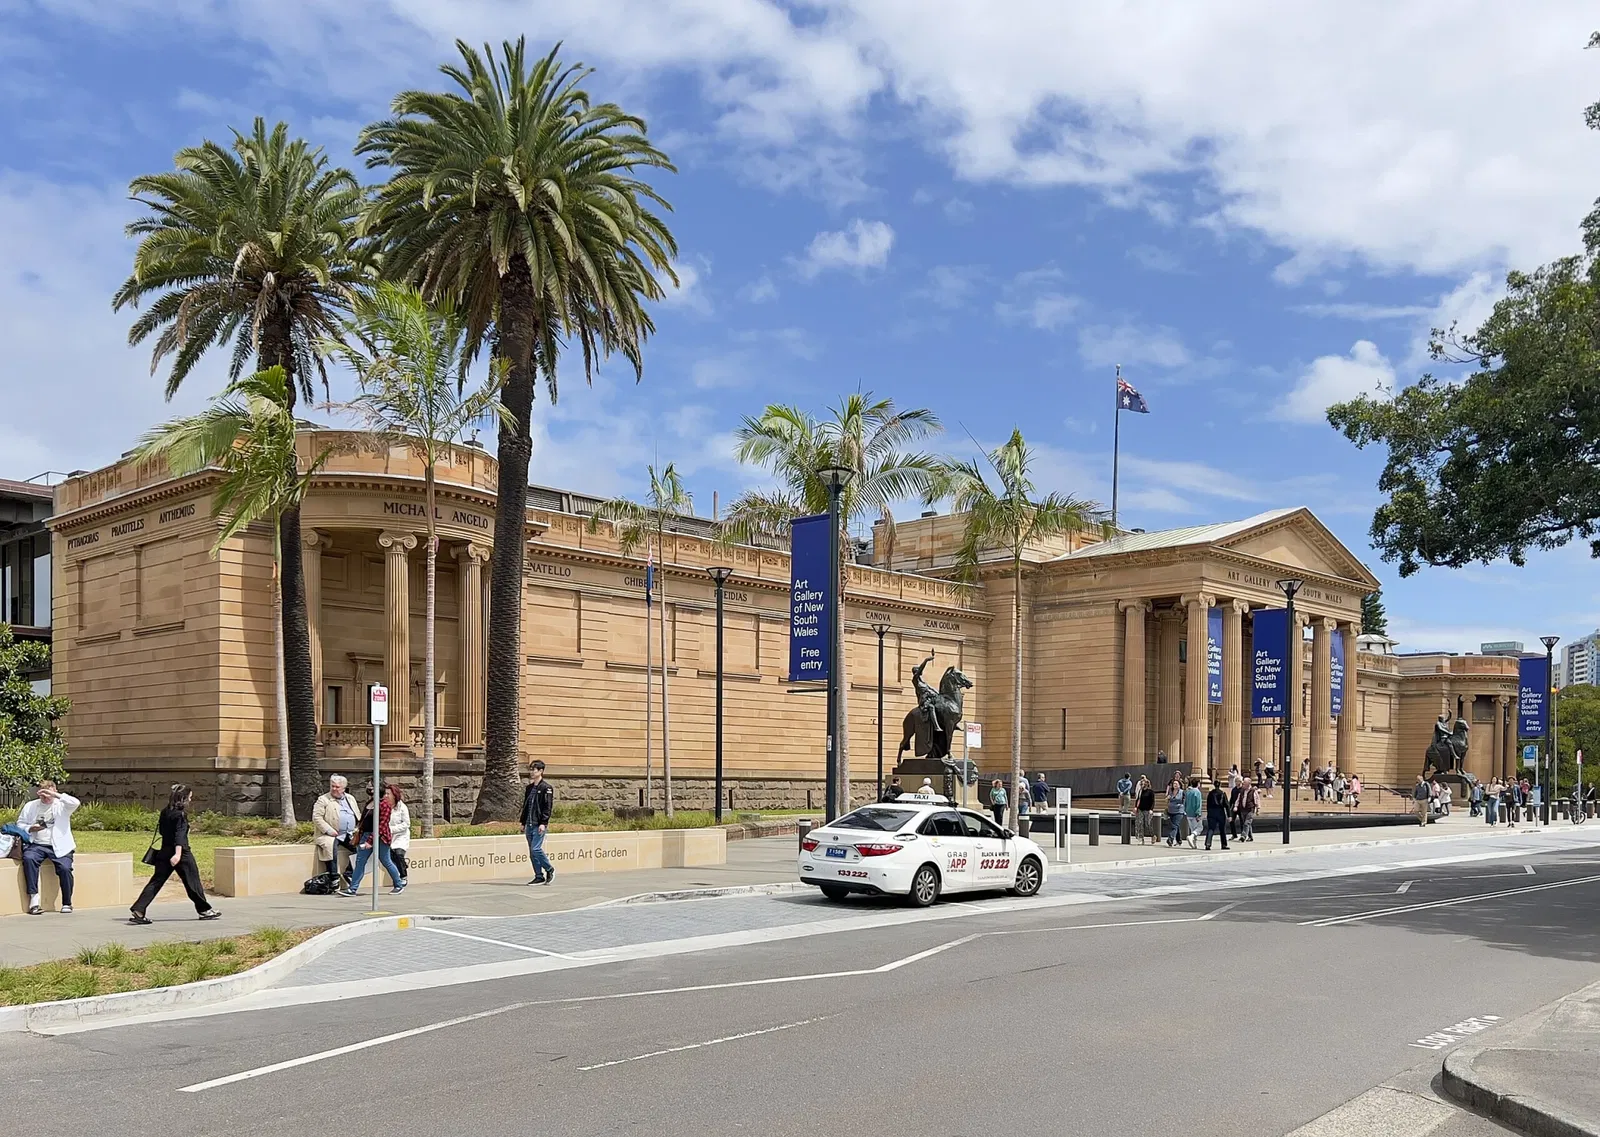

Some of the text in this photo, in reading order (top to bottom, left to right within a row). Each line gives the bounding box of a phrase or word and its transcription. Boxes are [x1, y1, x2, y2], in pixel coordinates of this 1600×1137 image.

[158, 504, 195, 524] ANTHEMIUS
[383, 502, 489, 529] MICHAL ANGELO
[111, 518, 145, 537] PRAXITELES
[794, 579, 808, 590] Art
[1228, 571, 1240, 581] ART
[1244, 575, 1271, 588] GALLERY
[1303, 588, 1321, 599] SOUTH
[1324, 593, 1343, 604] WALES
[714, 589, 748, 602] PEIDIAS
[794, 590, 823, 601] Gallery
[793, 602, 824, 614] of New
[793, 614, 818, 626] South
[865, 611, 891, 622] CANOVA
[923, 619, 938, 628] JEAN
[793, 626, 818, 638] Wales
[801, 647, 820, 657] Free
[800, 660, 823, 670] entry
[1264, 665, 1282, 673] New
[1255, 673, 1276, 681] South
[1261, 696, 1274, 704] Art
[1261, 704, 1272, 712] for
[434, 855, 455, 868] and
[457, 854, 485, 867] Ming
[488, 852, 509, 864] Tee
[509, 852, 528, 863] Lee
[557, 850, 575, 861] and
[578, 848, 592, 859] Art
[594, 847, 628, 858] Garden
[950, 858, 967, 868] APP
[980, 859, 1010, 869] 133 222
[837, 869, 868, 878] 133 222
